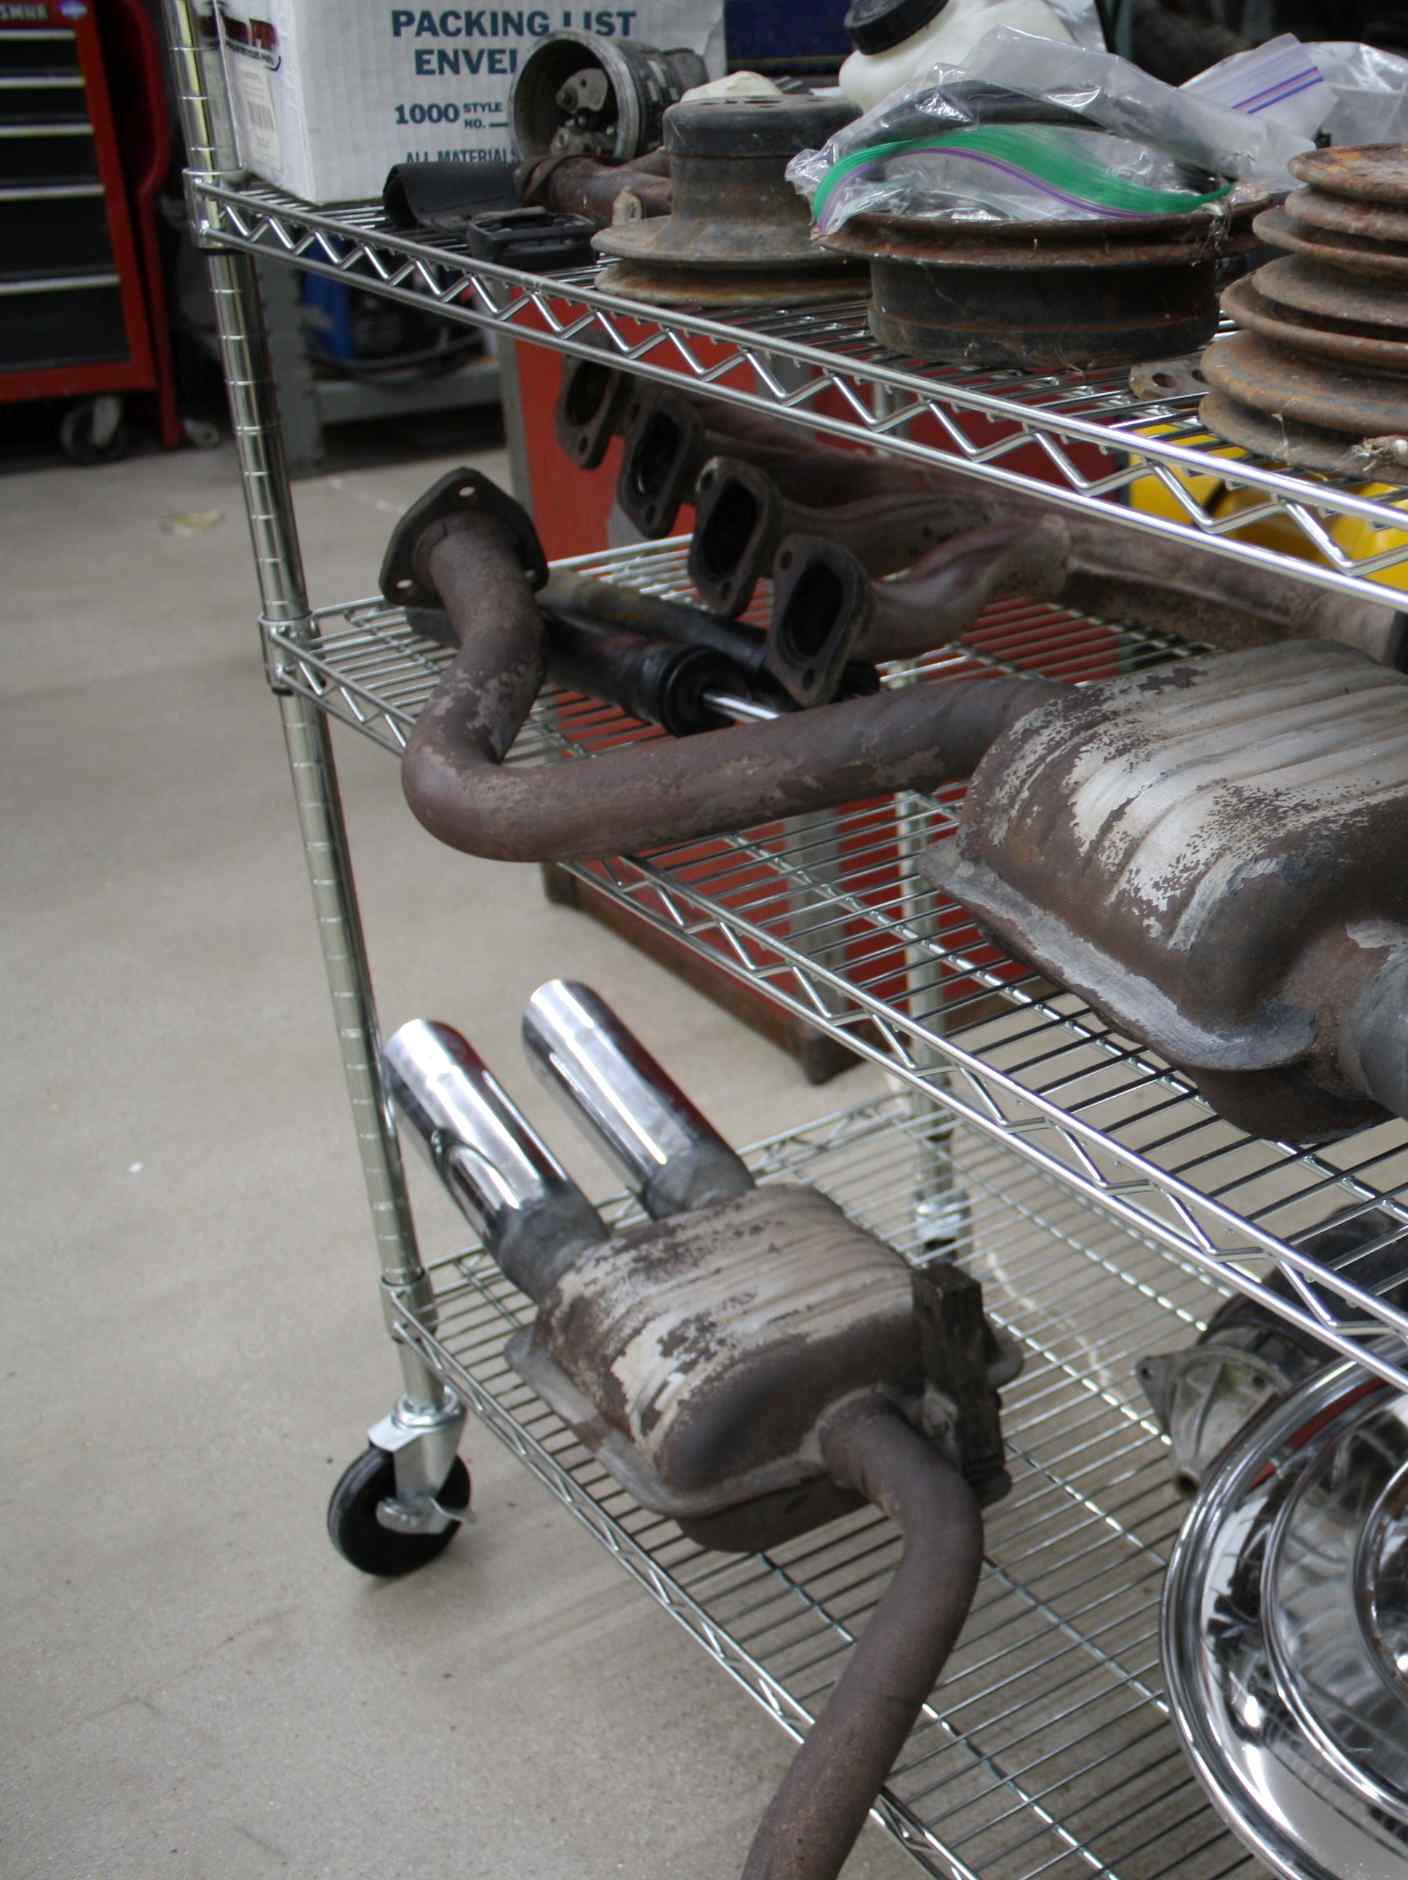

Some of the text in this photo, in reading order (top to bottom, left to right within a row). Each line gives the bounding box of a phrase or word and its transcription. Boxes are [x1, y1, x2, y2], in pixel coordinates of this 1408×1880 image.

[391, 9, 550, 38] PACKING
[394, 102, 502, 125] 1000 STYLE
[464, 119, 486, 129] NO.
